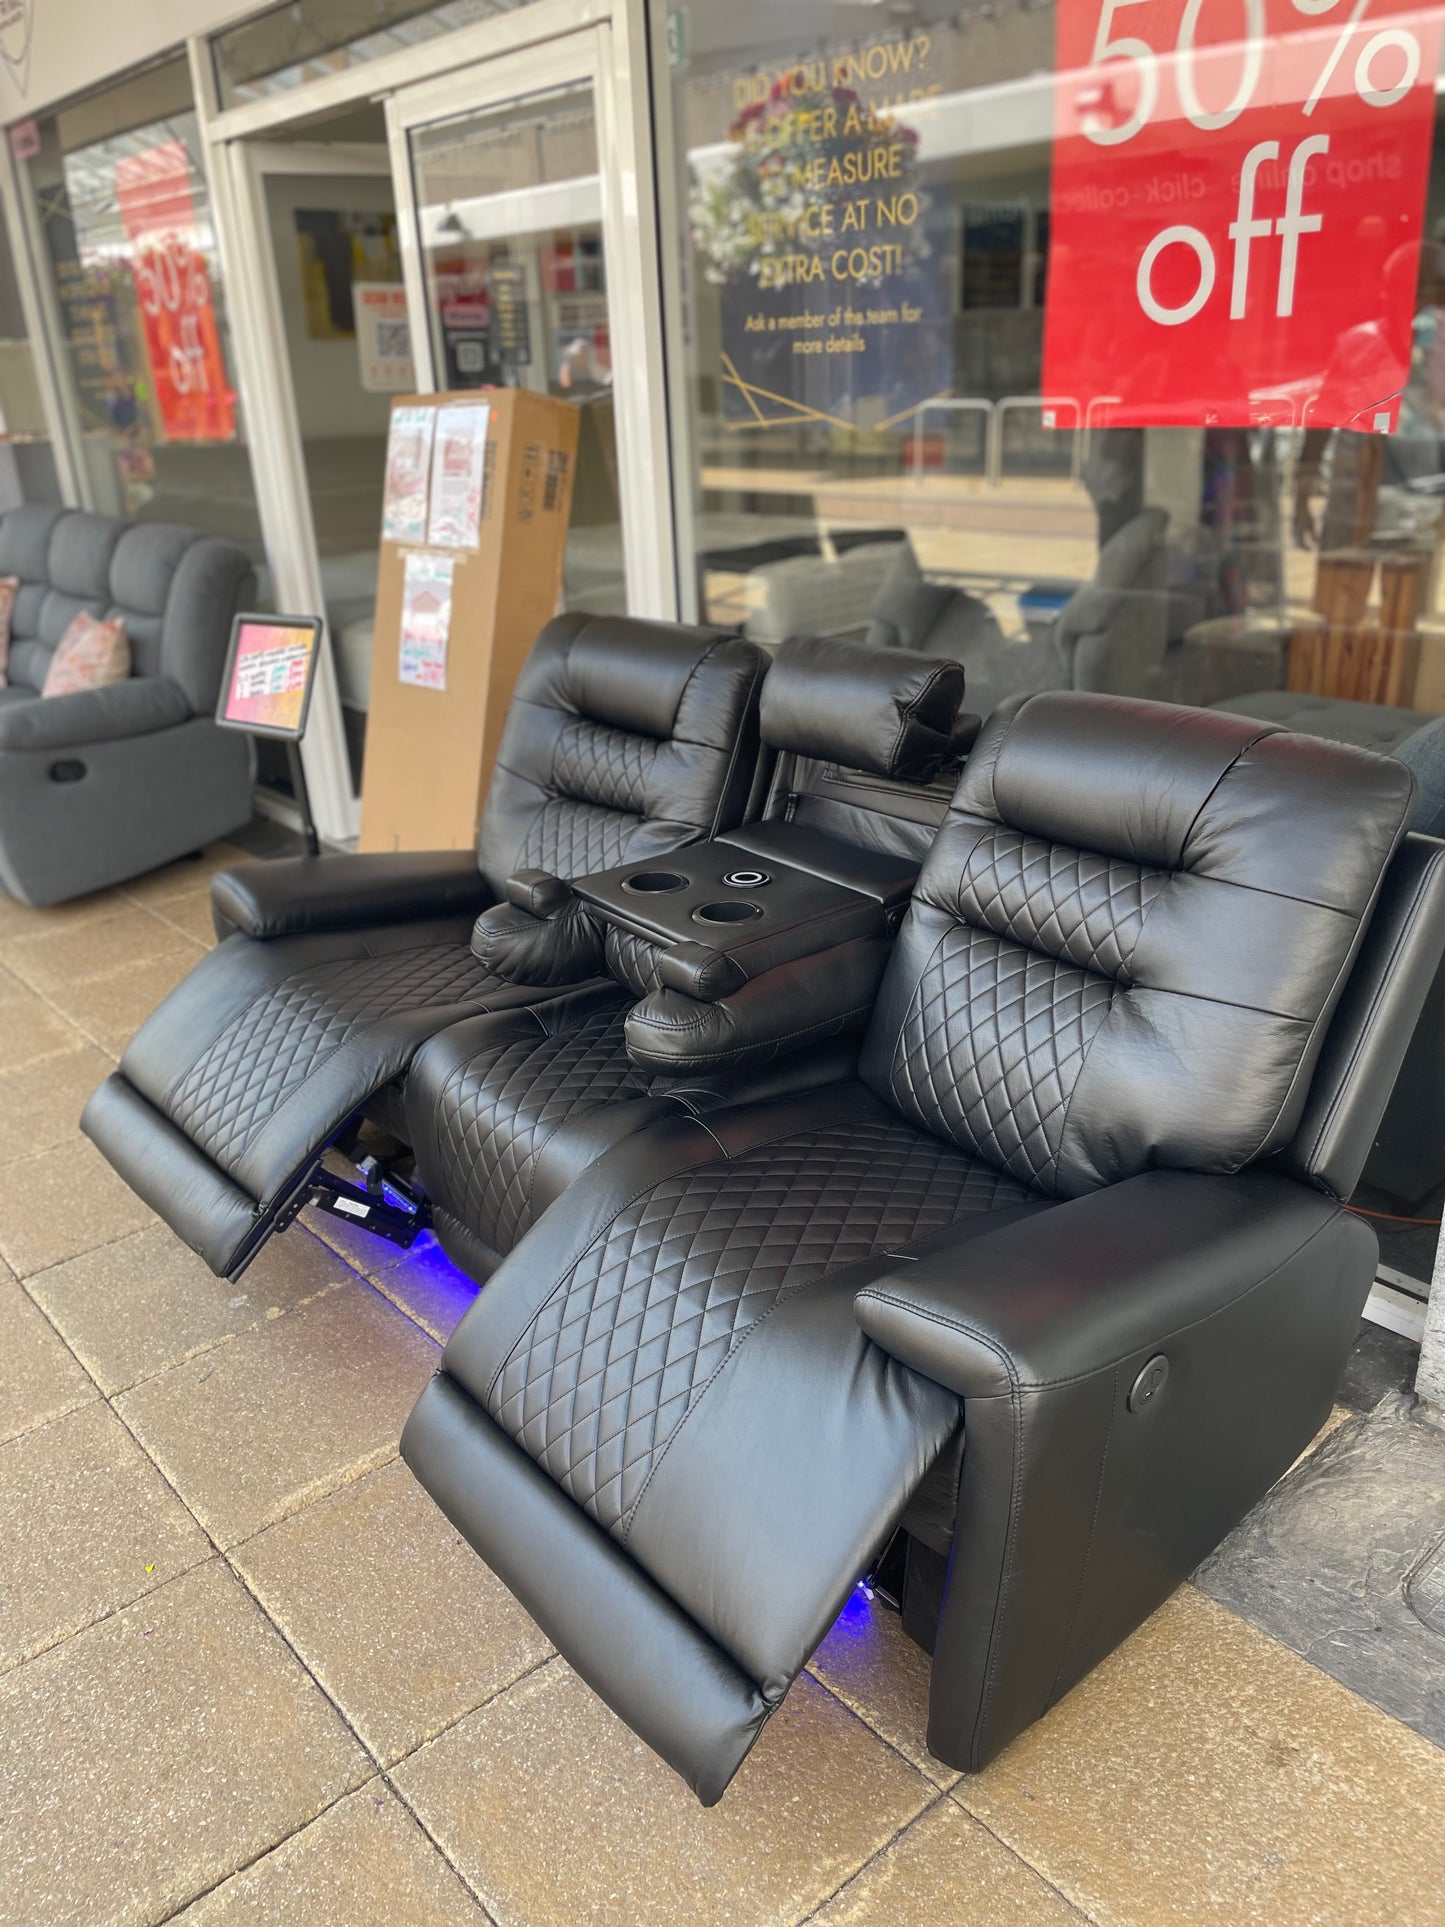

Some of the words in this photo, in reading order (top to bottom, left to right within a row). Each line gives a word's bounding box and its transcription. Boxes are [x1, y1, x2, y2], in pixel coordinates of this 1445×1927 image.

[775, 60, 826, 99] YOU
[832, 35, 931, 89] KNOW?
[1076, 0, 1421, 147] 50%
[763, 106, 837, 149] OFFER
[844, 104, 861, 137] A
[791, 144, 903, 192] MEASURE
[841, 199, 870, 233] AT
[876, 192, 919, 229] NO
[1136, 134, 1330, 326] off
[758, 253, 825, 288] EXTRA
[831, 244, 903, 281] COST!
[744, 312, 766, 333] Ask
[777, 309, 825, 330] member
[827, 307, 842, 327] of
[844, 305, 864, 325] the
[866, 308, 899, 325] team
[901, 302, 923, 324] for
[792, 339, 823, 354] more
[825, 333, 866, 354] details
